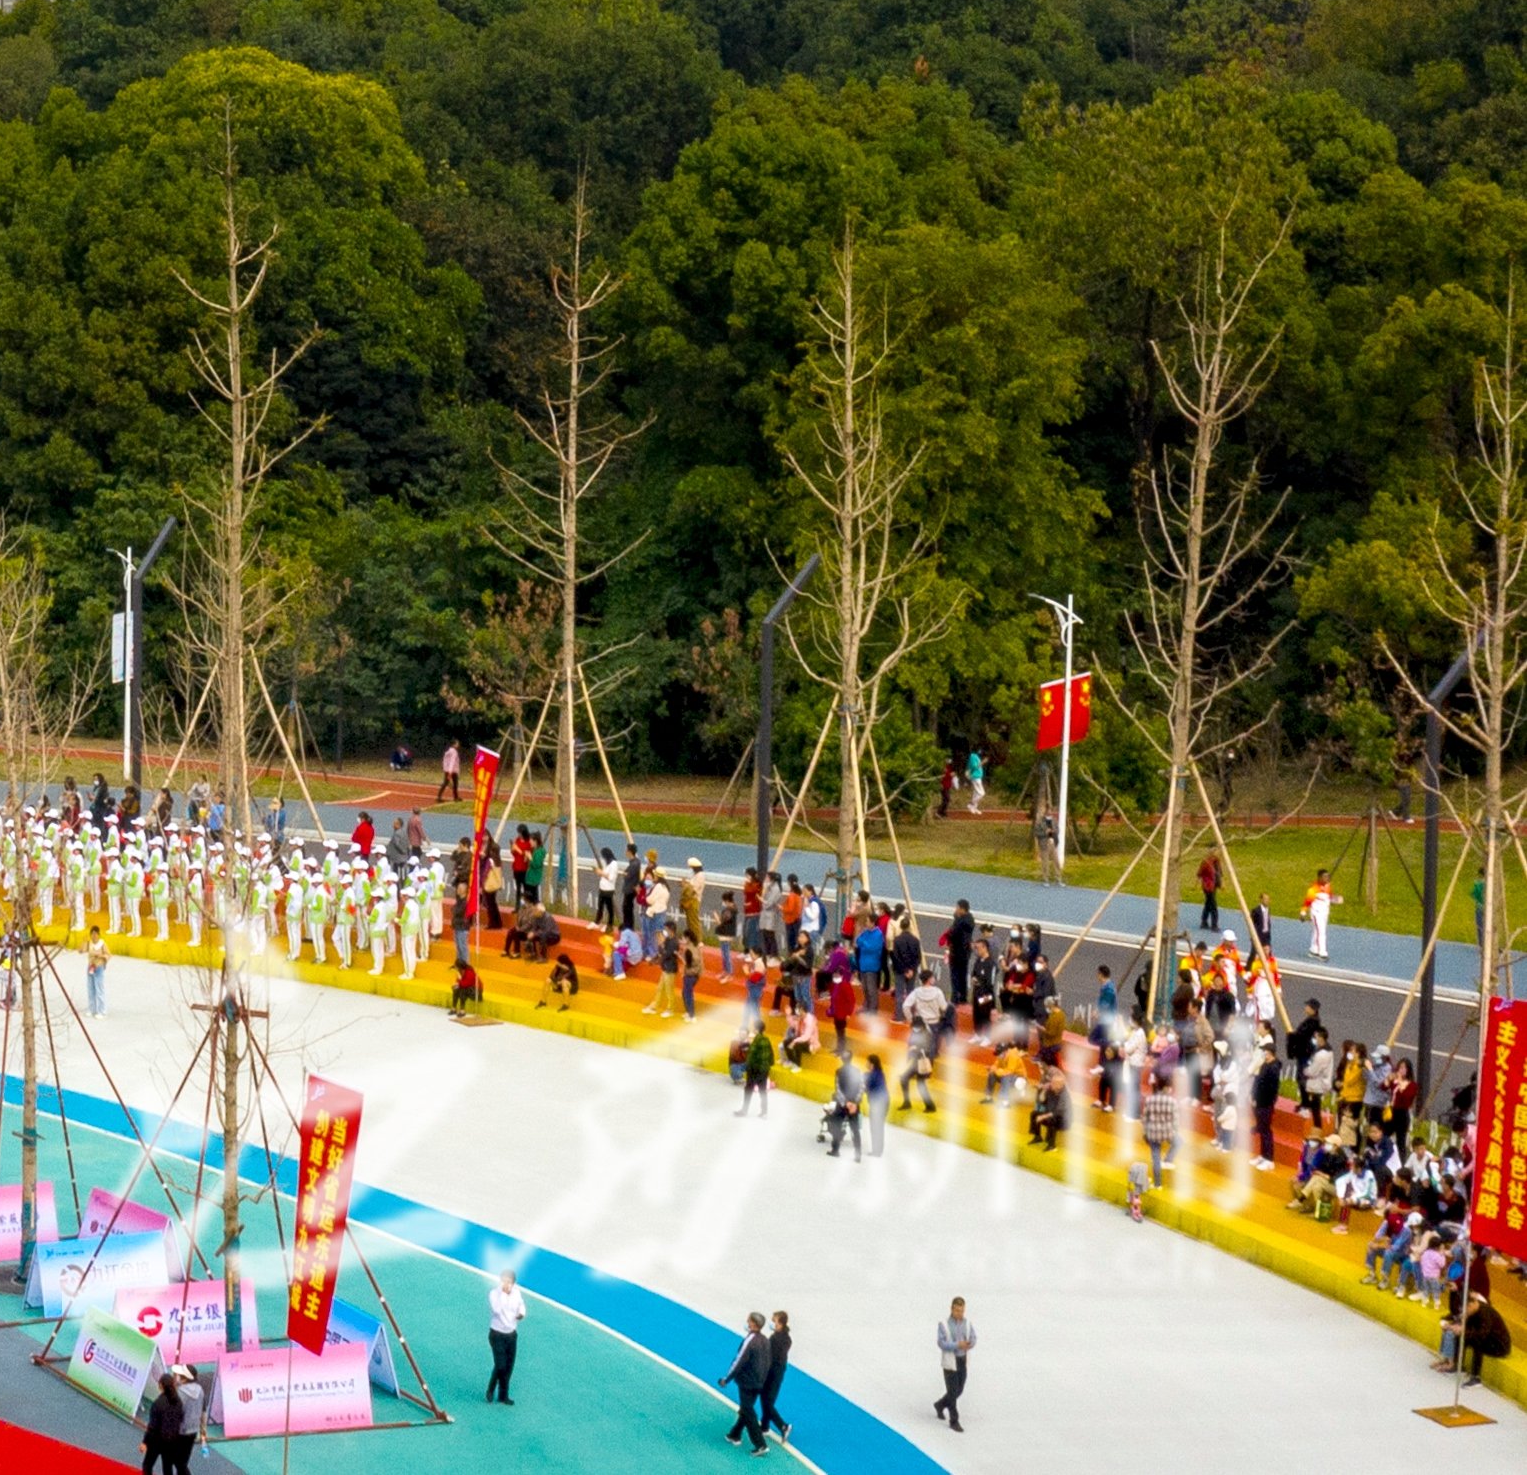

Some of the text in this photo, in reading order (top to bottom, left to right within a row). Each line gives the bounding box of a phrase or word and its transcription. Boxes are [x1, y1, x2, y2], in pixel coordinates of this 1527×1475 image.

[303, 1116, 348, 1321] 当好省运东道主
[1475, 1019, 1519, 1220] 主义文化发展道路
[169, 1303, 222, 1323] 九江银
